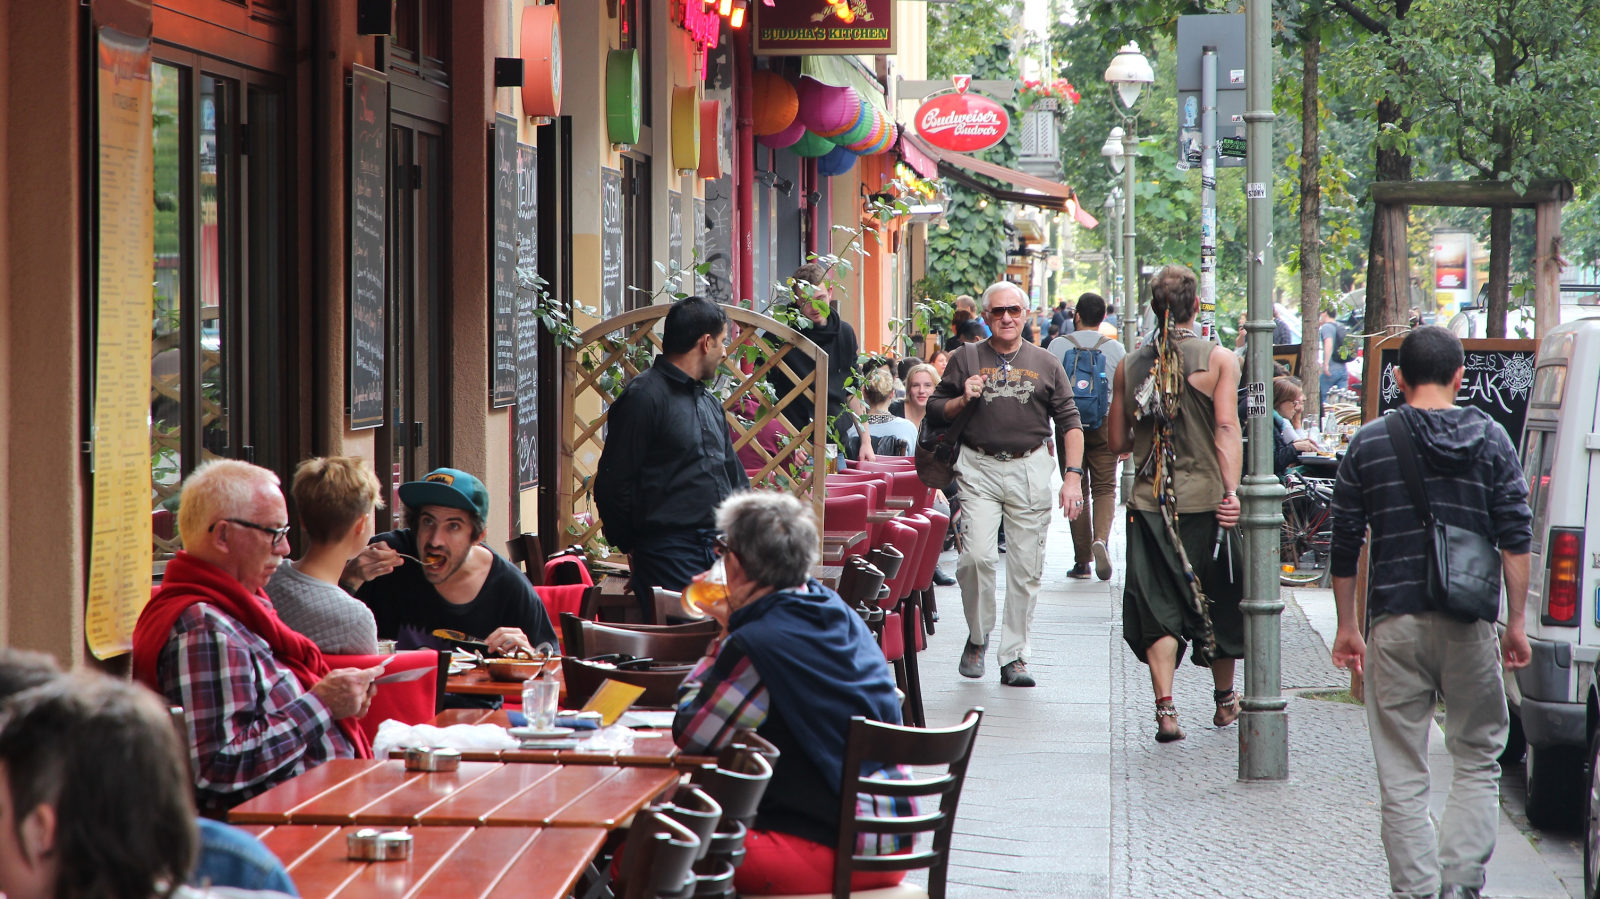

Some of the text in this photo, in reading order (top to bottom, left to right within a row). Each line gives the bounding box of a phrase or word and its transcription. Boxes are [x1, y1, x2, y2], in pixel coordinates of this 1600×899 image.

[761, 27, 888, 40] BUDDHA'S KITCHEN
[921, 107, 1001, 130] Budweiser
[954, 122, 998, 135] Budvar
[1455, 372, 1513, 413] EAK
